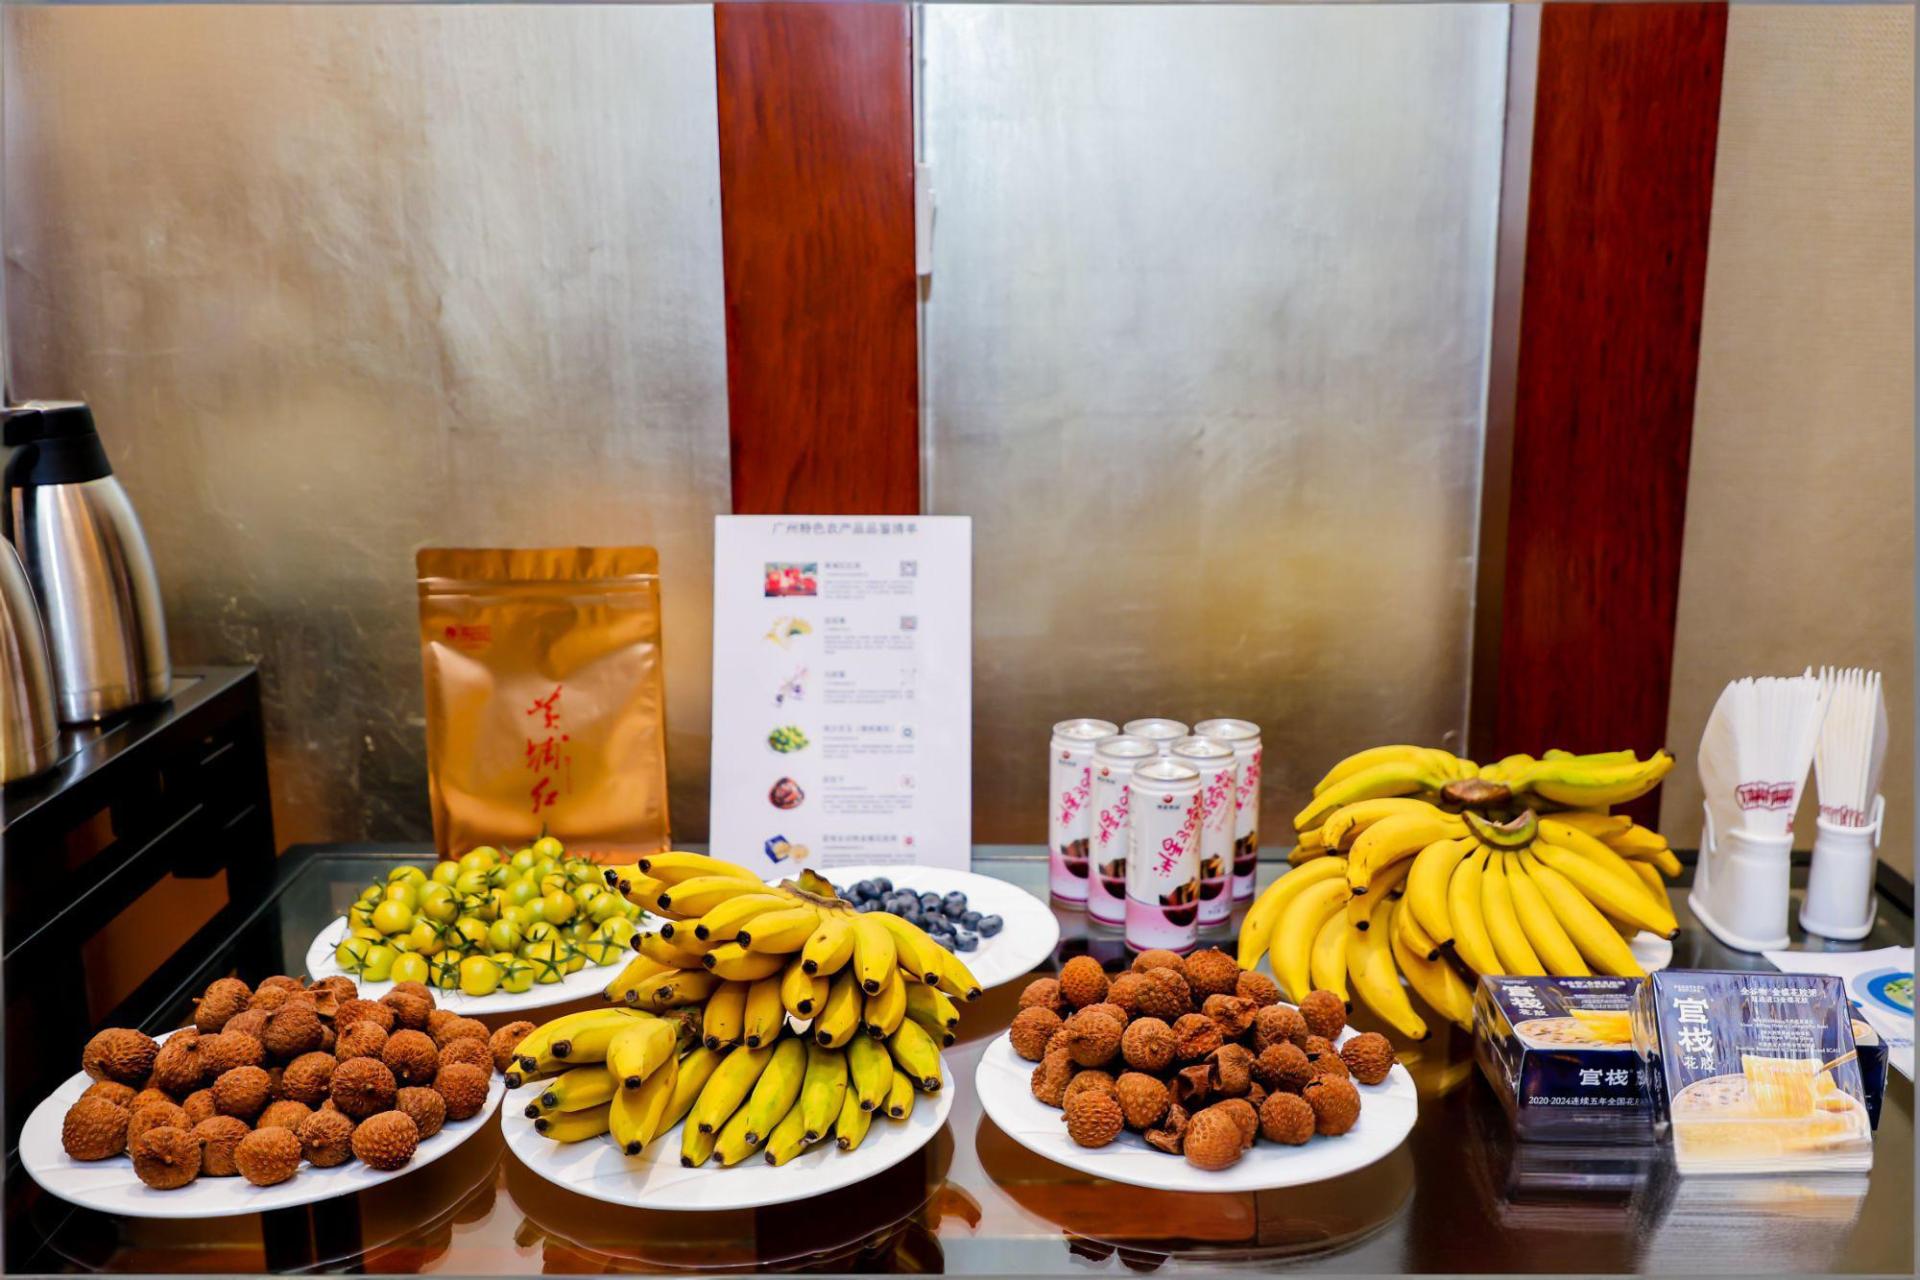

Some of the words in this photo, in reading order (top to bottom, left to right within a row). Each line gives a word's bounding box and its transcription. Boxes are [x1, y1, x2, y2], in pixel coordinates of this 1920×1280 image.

[1673, 998, 1715, 1053] 官栈
[1683, 1056, 1716, 1072] 花胶
[1579, 1068, 1629, 1087] 官栈
